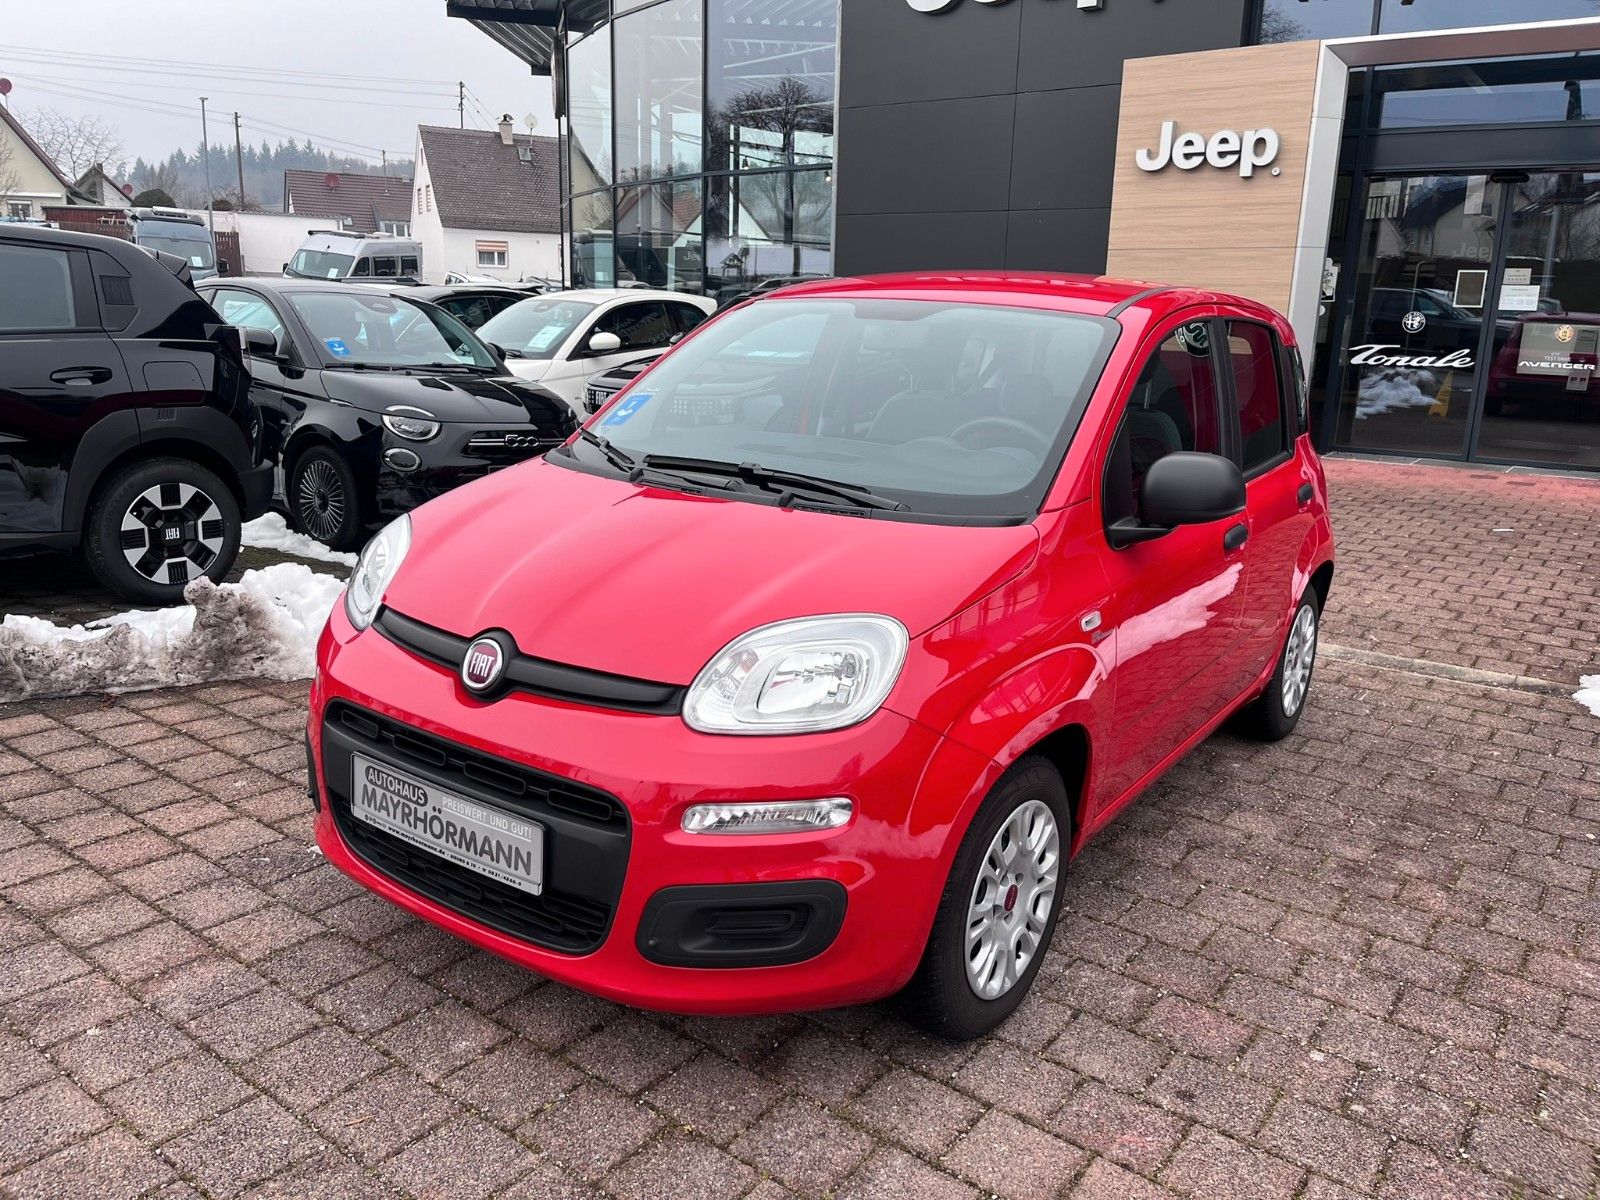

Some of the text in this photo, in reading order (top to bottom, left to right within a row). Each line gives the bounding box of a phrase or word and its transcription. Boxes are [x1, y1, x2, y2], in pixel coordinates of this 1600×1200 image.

[1135, 120, 1279, 179] Jeep
[1348, 343, 1476, 368] Tonale
[1518, 360, 1596, 371] AVENGER
[505, 434, 540, 448] 500
[165, 527, 180, 540] FIAT
[469, 652, 495, 677] FIAT
[367, 768, 425, 804] AUTOHAUS
[361, 783, 532, 876] MAYRHÖRMANN
[442, 796, 532, 839] PREISWERT UND GUT!
